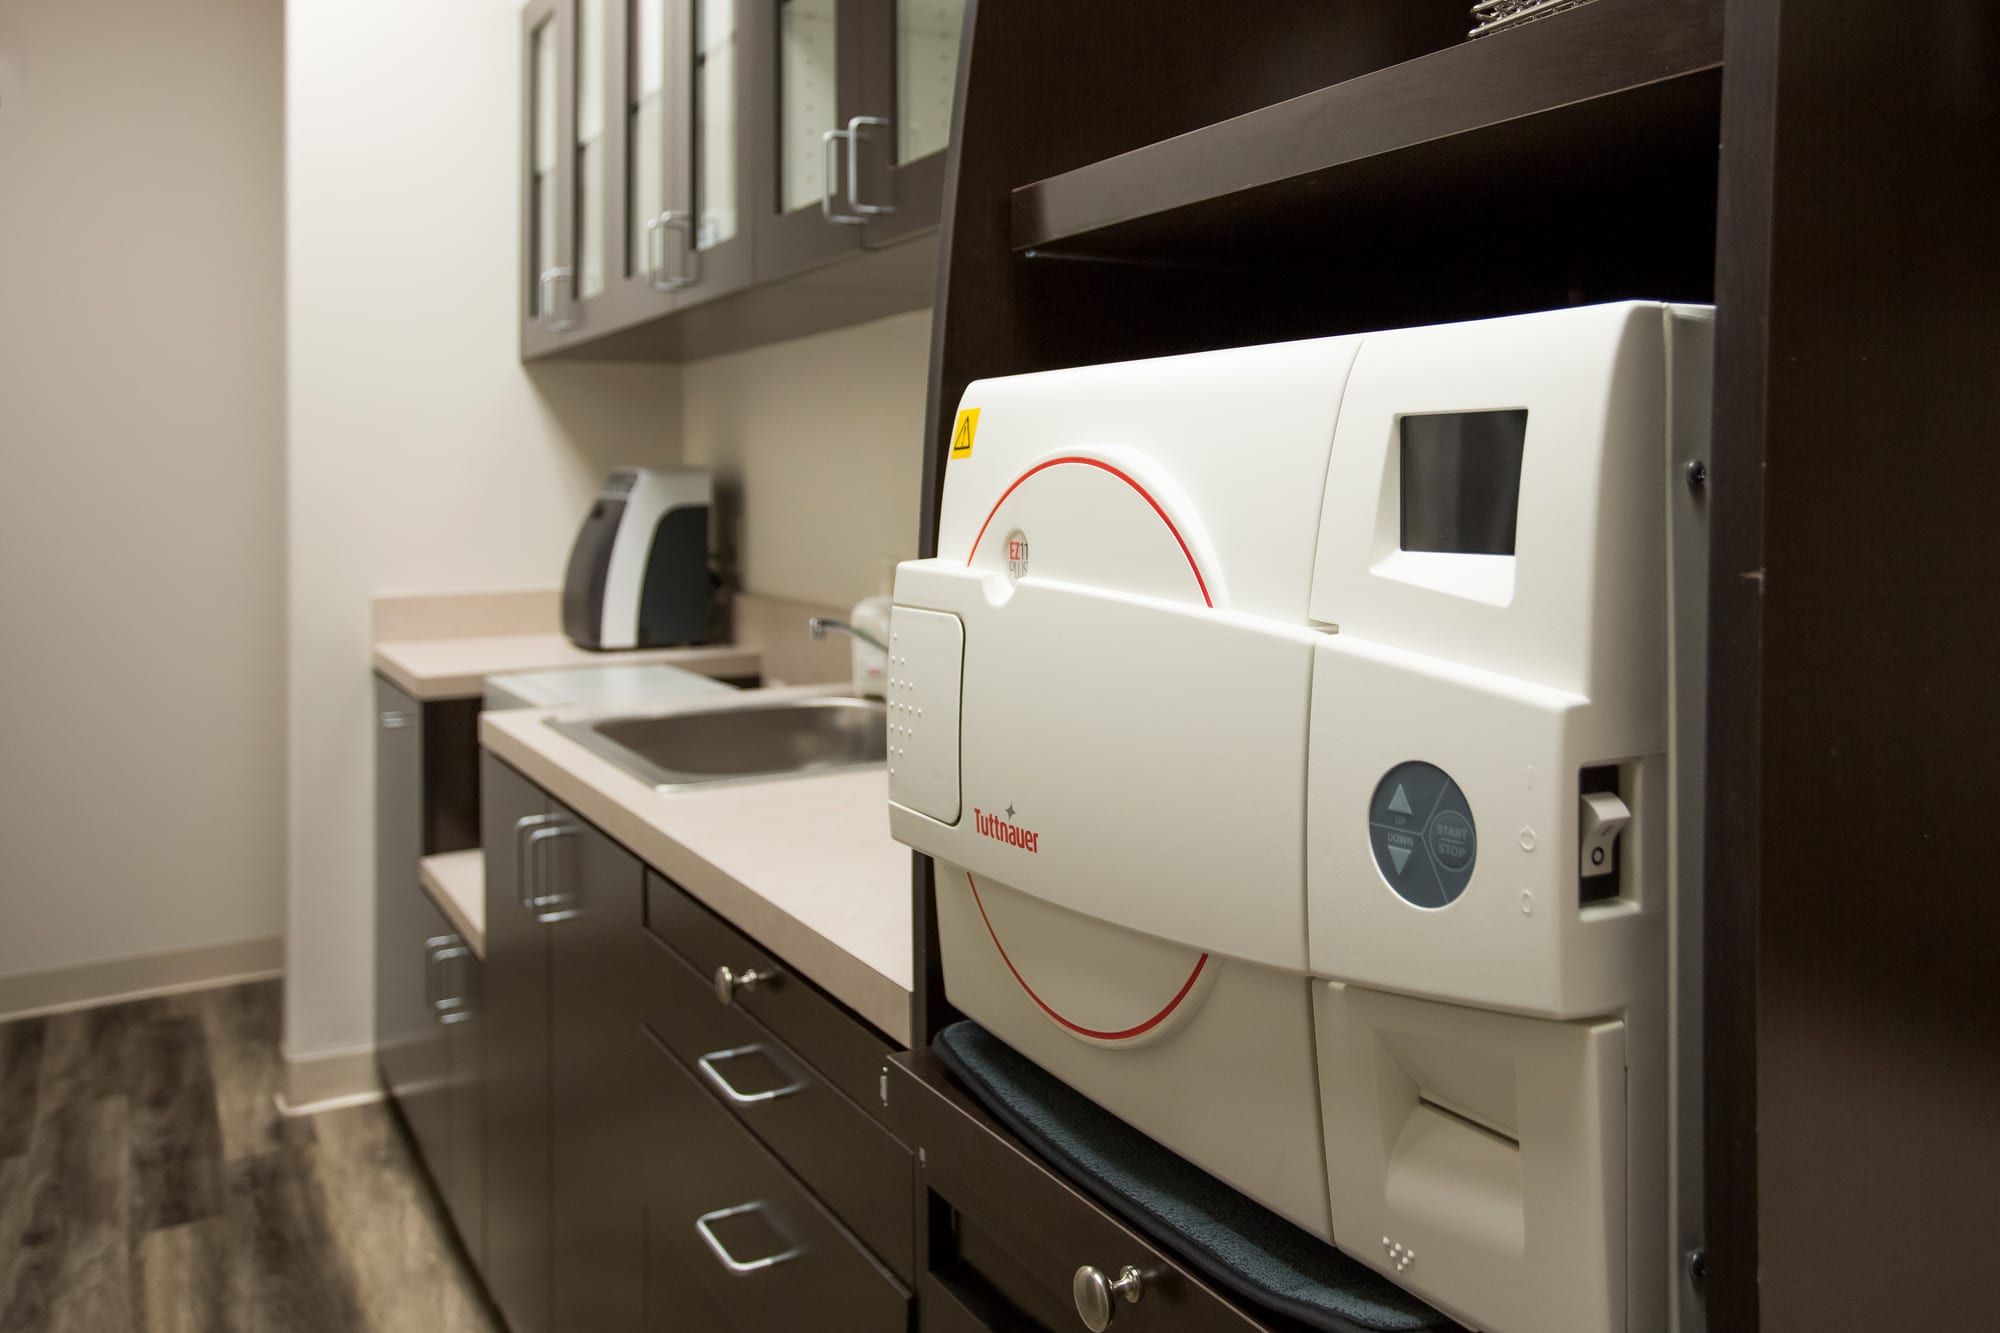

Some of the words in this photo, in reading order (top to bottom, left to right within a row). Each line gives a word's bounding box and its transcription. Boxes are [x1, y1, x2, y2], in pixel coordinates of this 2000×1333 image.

[1009, 541, 1028, 560] EZ11
[1009, 560, 1028, 578] PLUS
[974, 808, 1039, 853] Tuttnauer
[1437, 825, 1467, 840] START
[1387, 832, 1413, 847] DOWN
[1438, 844, 1466, 857] STOP
